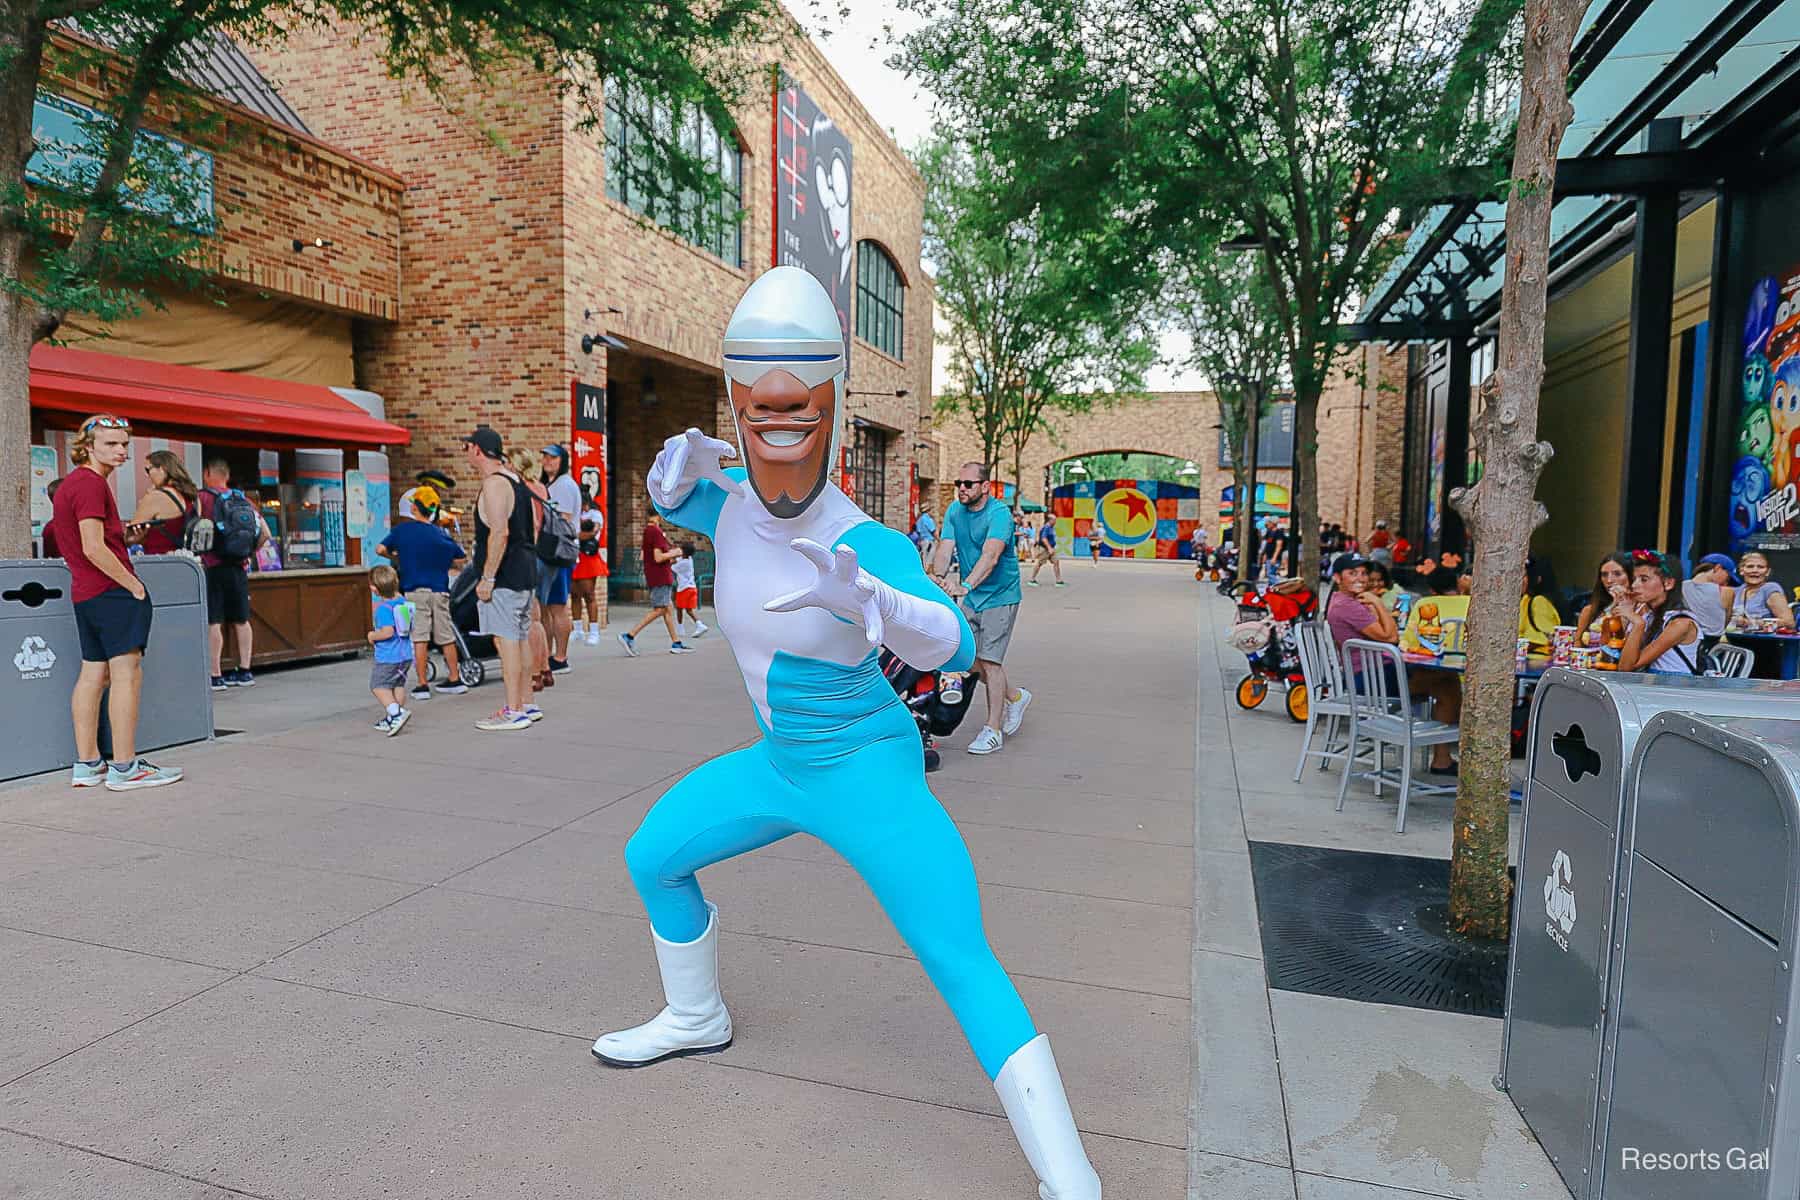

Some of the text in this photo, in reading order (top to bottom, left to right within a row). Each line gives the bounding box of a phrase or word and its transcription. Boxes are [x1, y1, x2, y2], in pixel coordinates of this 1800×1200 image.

[784, 229, 800, 252] THE
[583, 394, 599, 420] M
[1766, 505, 1785, 532] OUT
[1783, 482, 1800, 521] 2
[1545, 921, 1568, 953] RECYCLE
